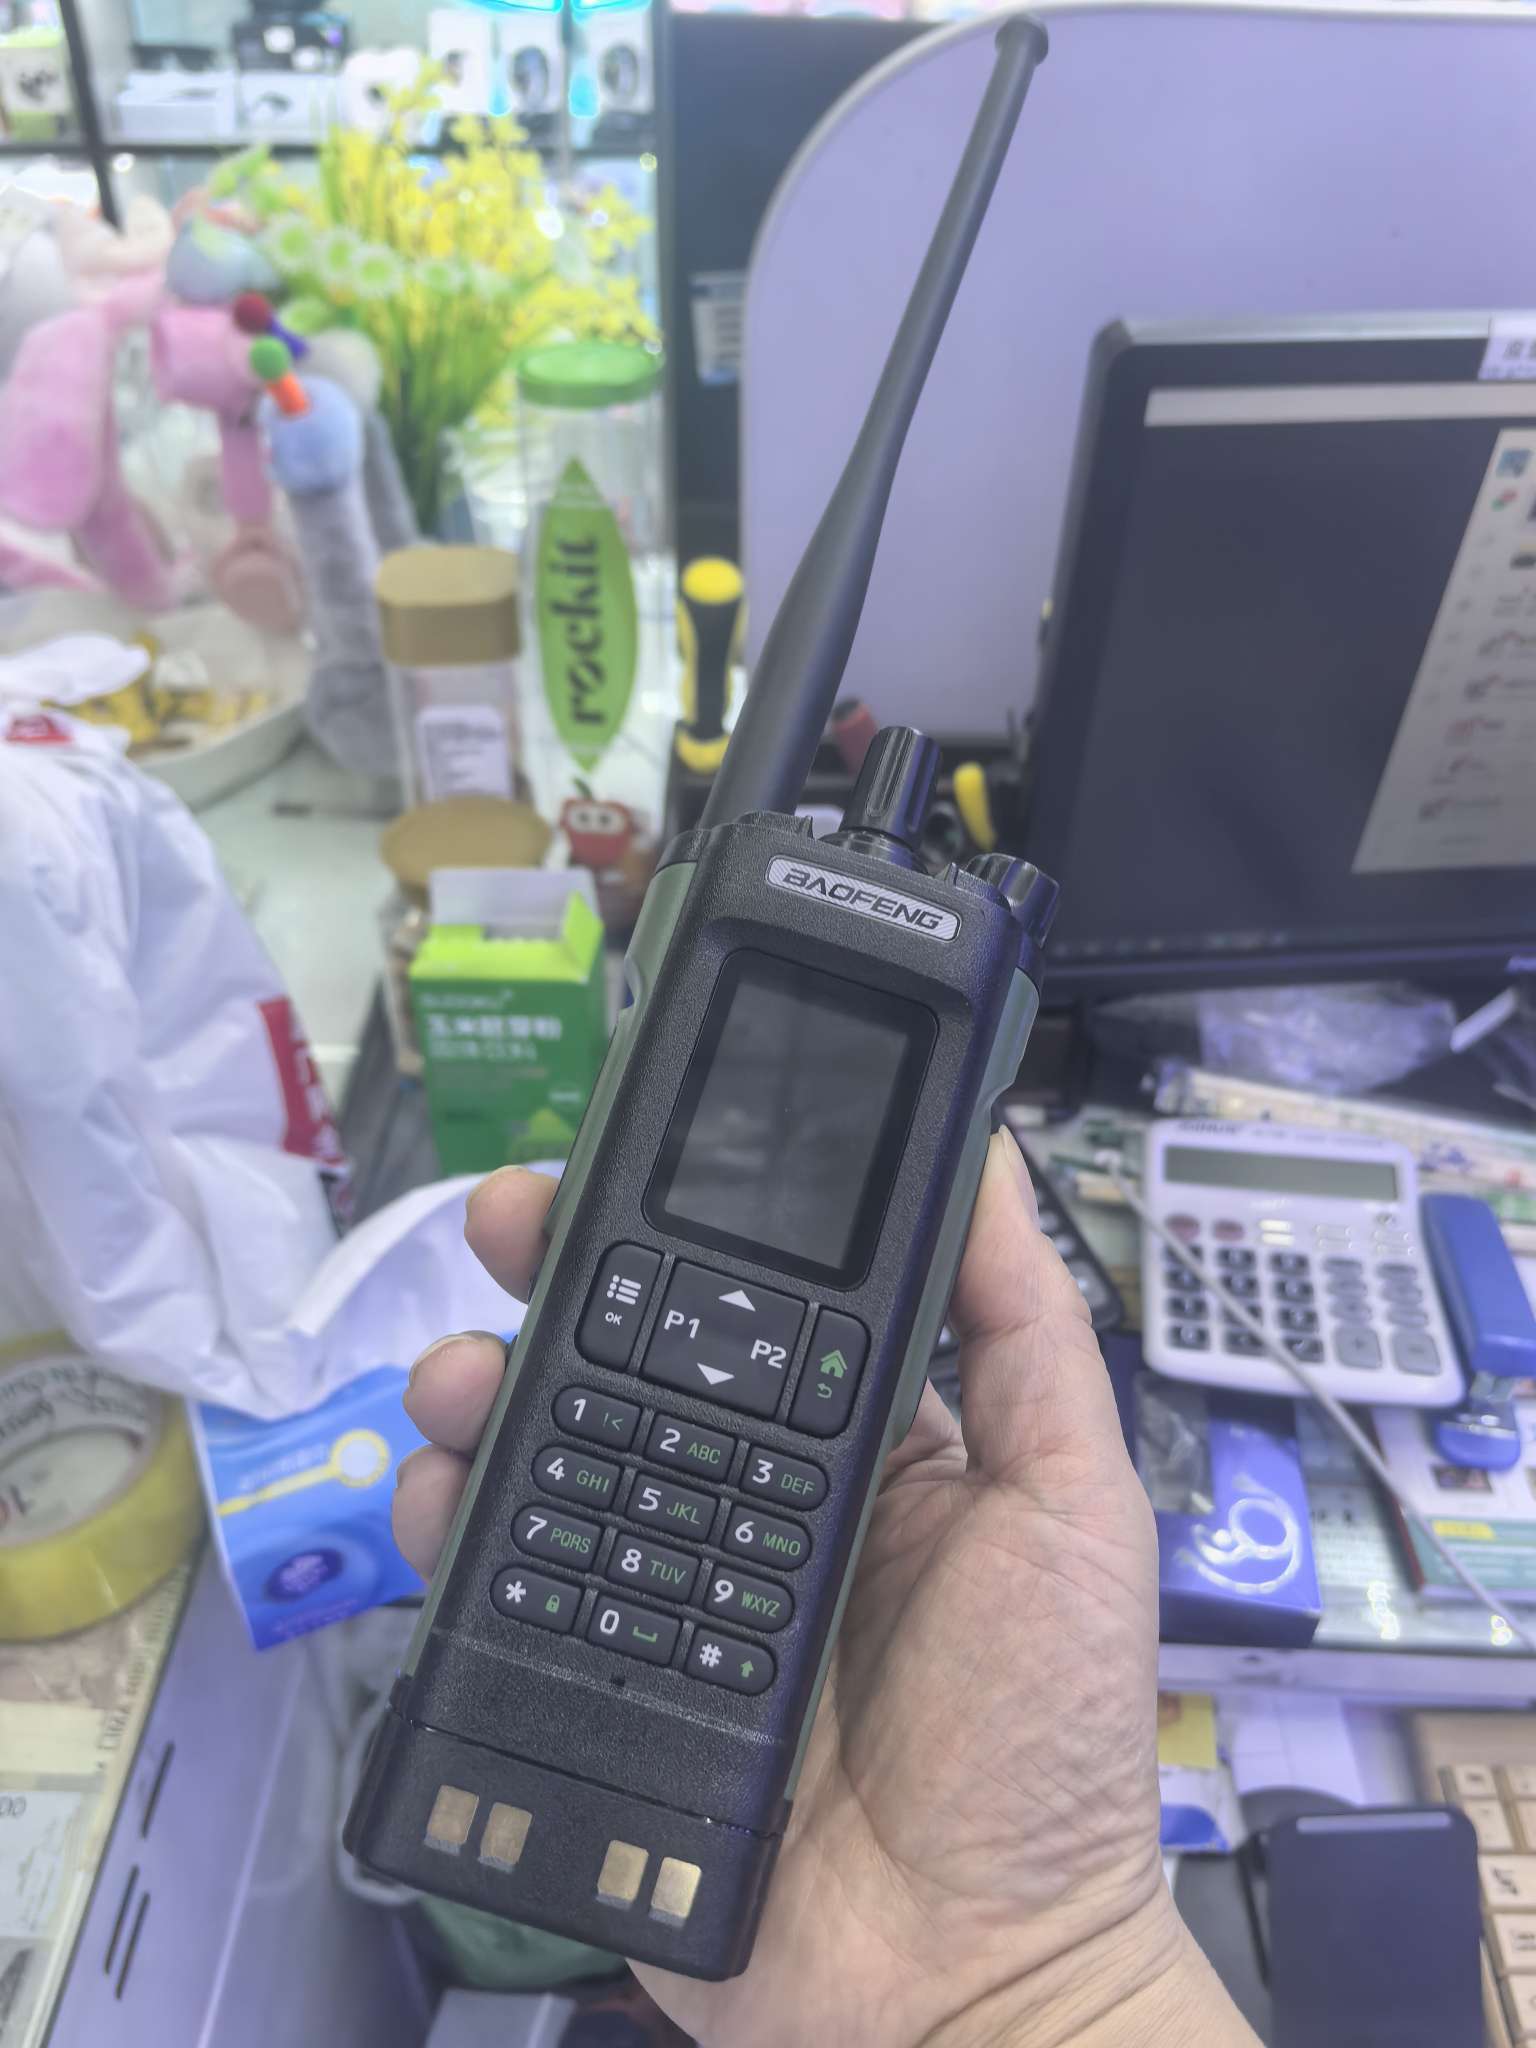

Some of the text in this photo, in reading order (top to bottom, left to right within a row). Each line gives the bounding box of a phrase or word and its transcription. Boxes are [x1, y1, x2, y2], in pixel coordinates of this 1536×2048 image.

[549, 536, 606, 728] rockit
[783, 868, 943, 930] BAOFENG
[604, 1311, 623, 1326] OK
[663, 1309, 701, 1339] P1
[750, 1339, 787, 1369] P2
[573, 1398, 587, 1421] 1
[659, 1427, 721, 1465] 2 ABC
[546, 1457, 610, 1493] 4 GHI
[752, 1458, 815, 1496] 3 DEF
[638, 1487, 700, 1525] 5 JKL
[526, 1515, 591, 1554] 7 PQRS
[734, 1520, 801, 1556] 6 MNO
[621, 1548, 687, 1585] 8 TUV
[714, 1579, 781, 1618] 9 WXYZ
[599, 1609, 620, 1635] 0
